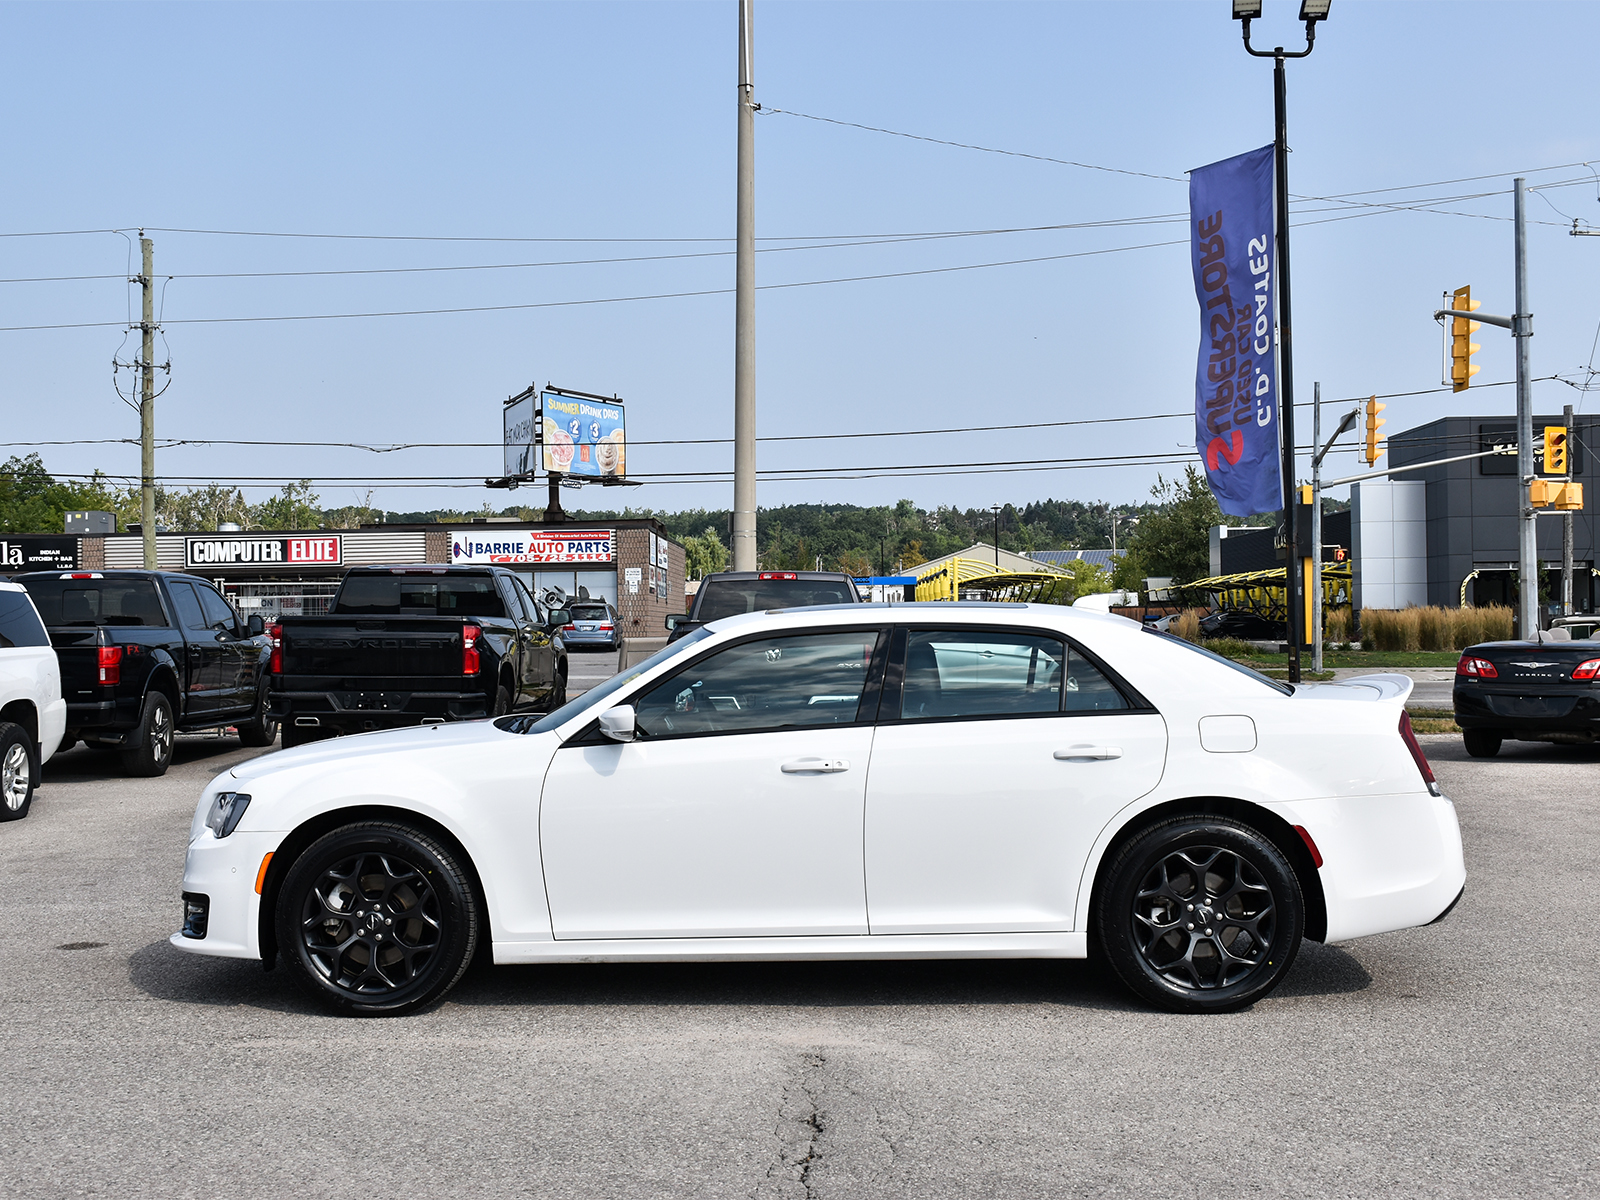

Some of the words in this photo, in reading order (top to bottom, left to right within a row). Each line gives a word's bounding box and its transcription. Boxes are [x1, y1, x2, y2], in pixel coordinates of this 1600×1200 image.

[548, 398, 580, 416] SUMMER
[580, 403, 603, 419] DRINK
[602, 409, 620, 421] DAYS
[193, 541, 282, 563] COMPUTER
[291, 539, 334, 561] ELITE
[475, 542, 524, 554] BARRIE
[528, 542, 564, 554] AUTO
[568, 541, 610, 553] PARTS
[509, 553, 608, 562] 705-725-1114
[291, 639, 450, 649] CHEVROLET
